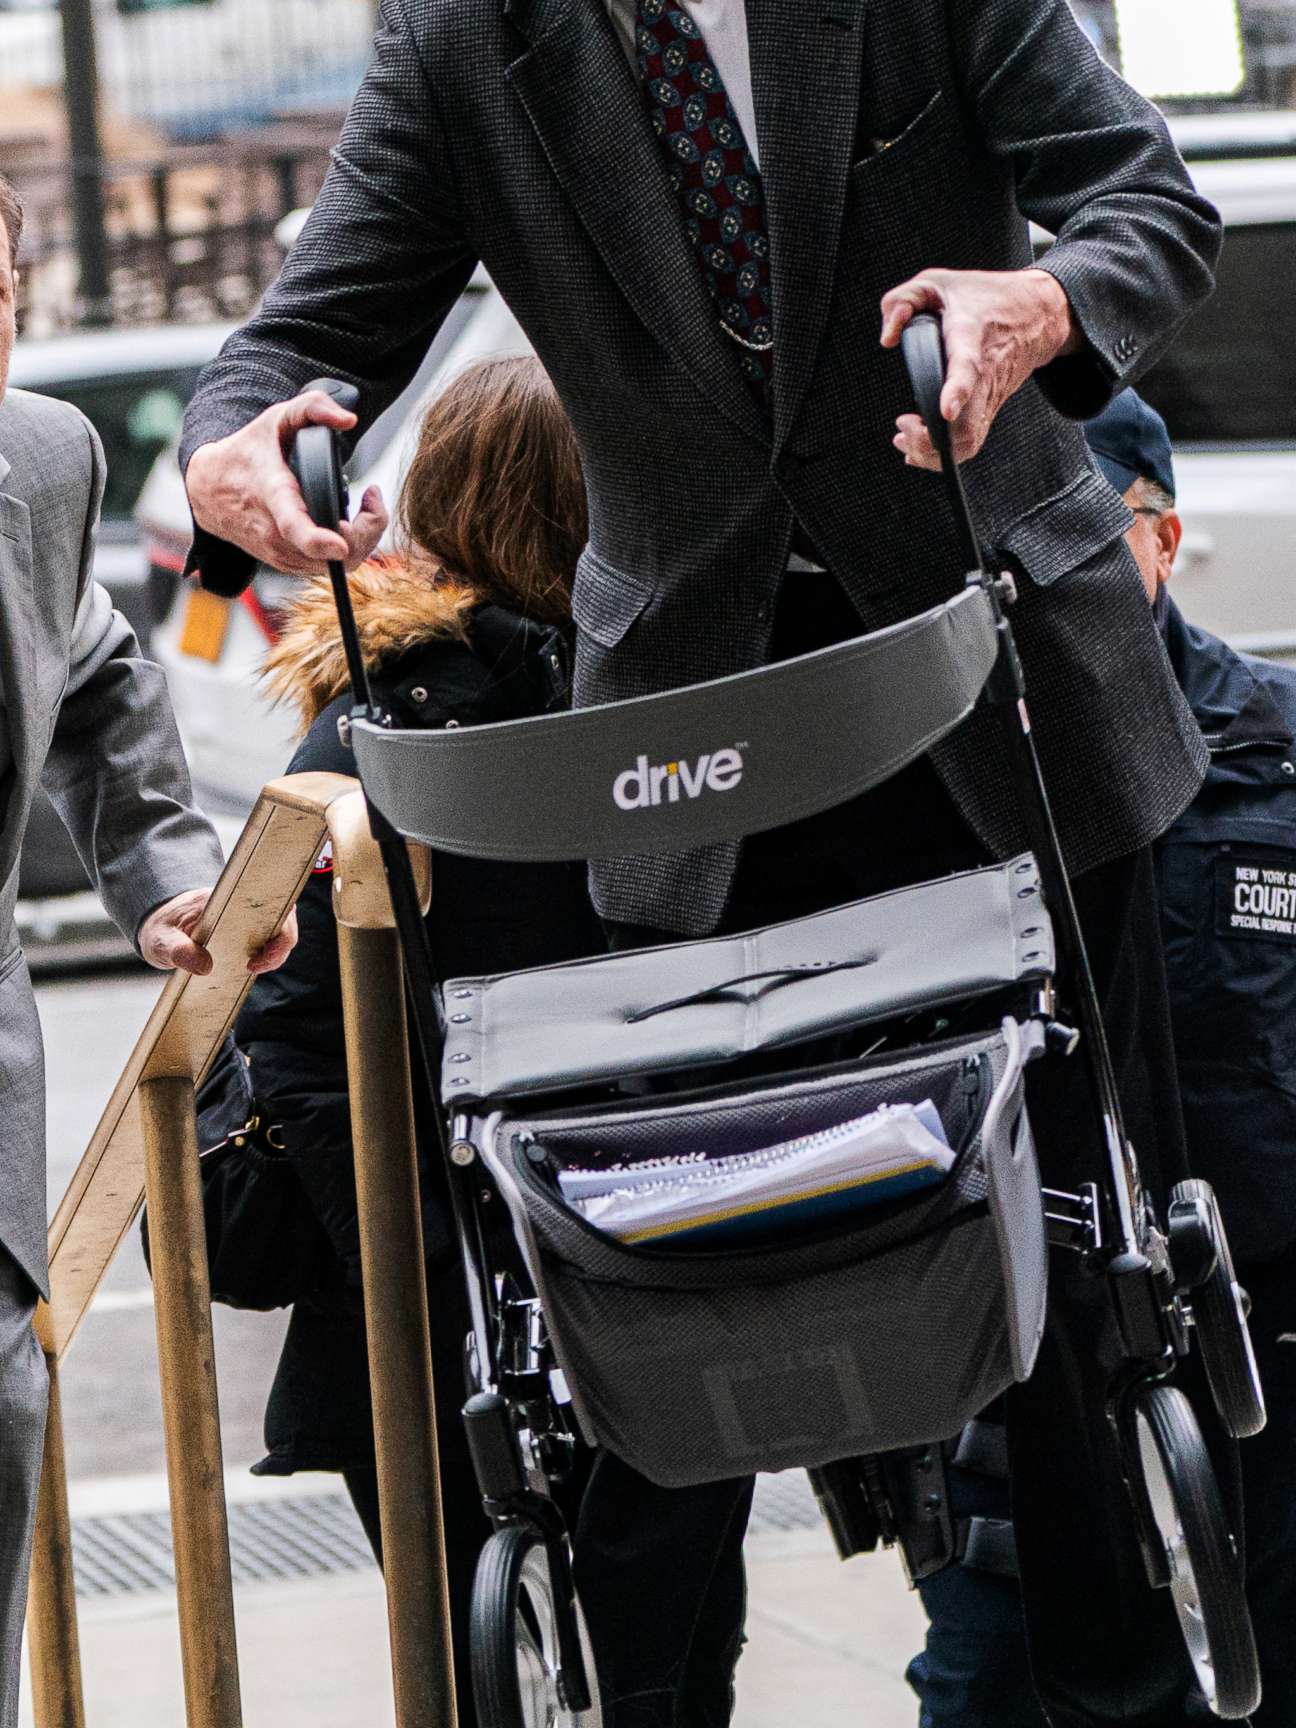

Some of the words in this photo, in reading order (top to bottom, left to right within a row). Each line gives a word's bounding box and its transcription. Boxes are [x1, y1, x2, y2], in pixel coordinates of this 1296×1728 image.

[612, 748, 743, 810] drive
[1235, 866, 1259, 882] NEW
[1262, 869, 1287, 885] YORK
[1234, 882, 1296, 919] COURT
[1230, 914, 1260, 929] SPECIAL
